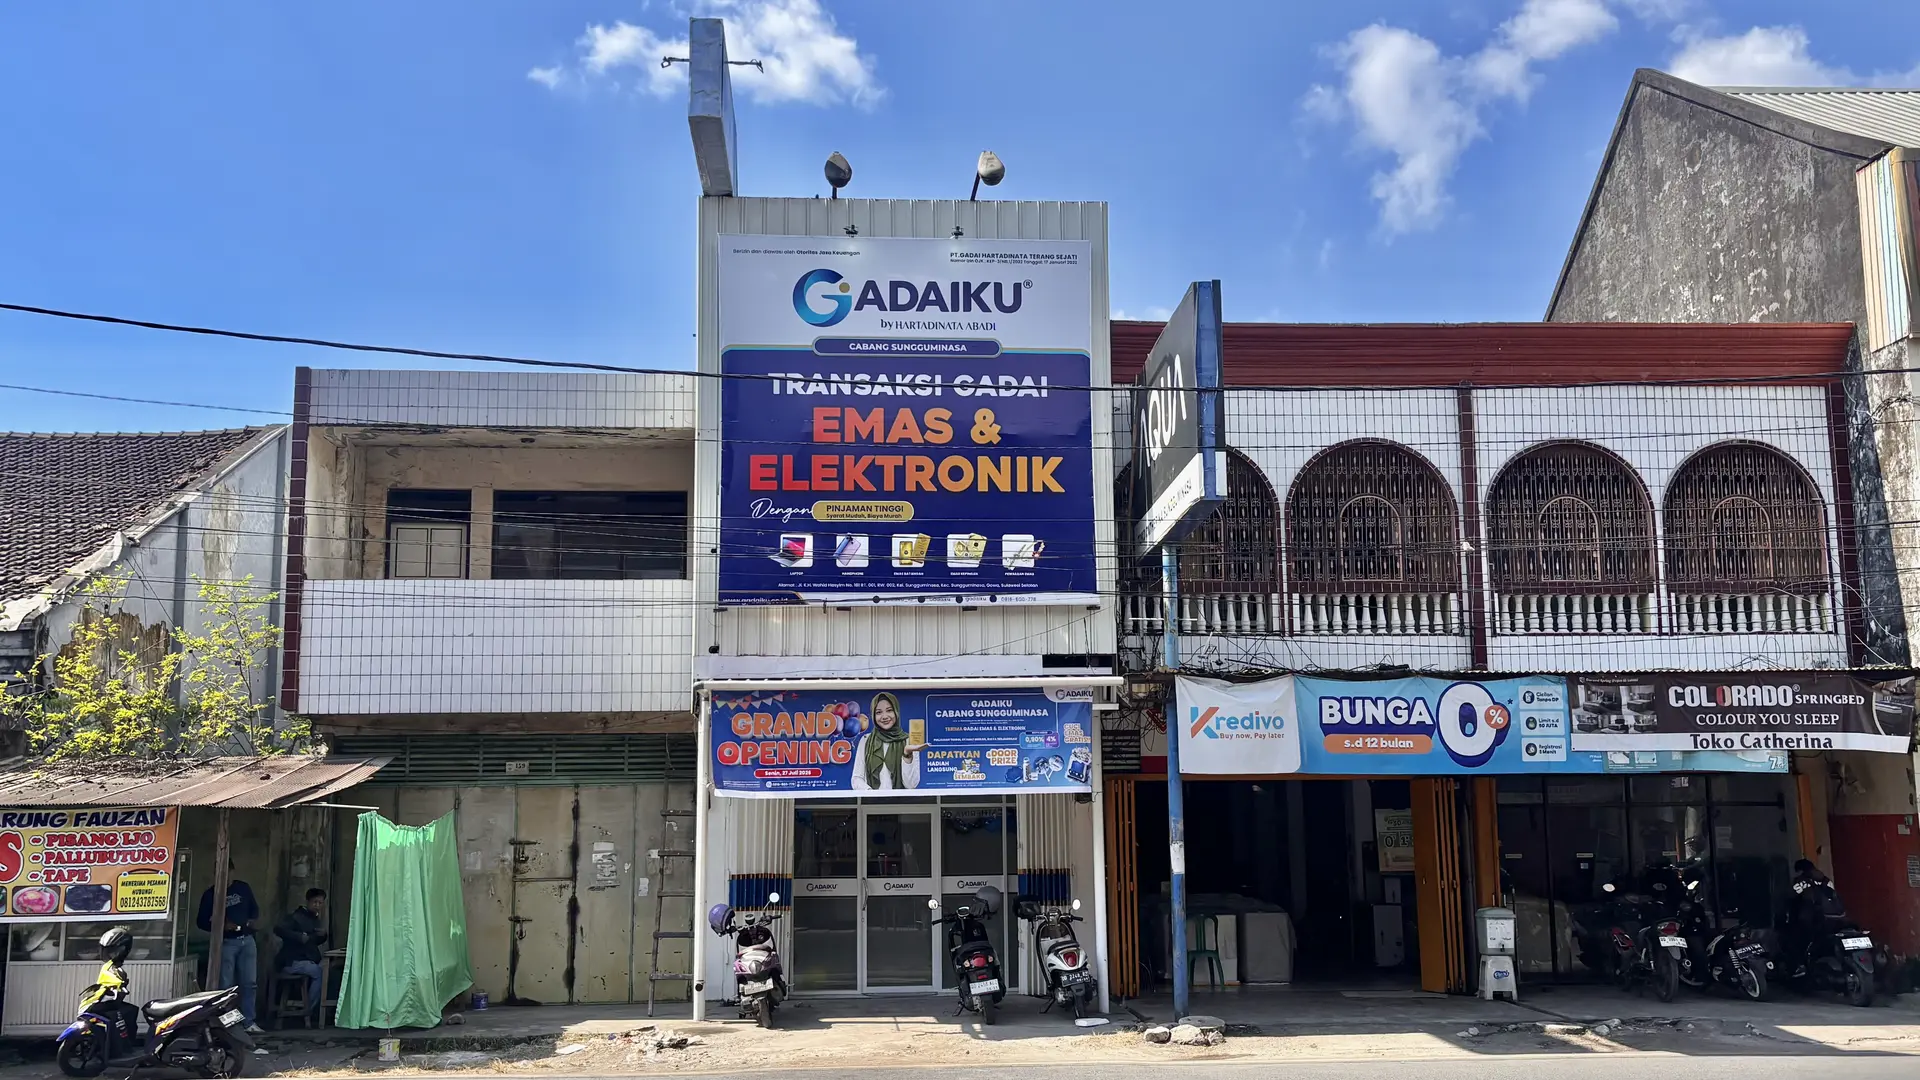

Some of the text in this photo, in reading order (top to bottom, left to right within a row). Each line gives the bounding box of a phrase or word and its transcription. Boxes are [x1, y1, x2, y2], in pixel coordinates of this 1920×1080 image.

[880, 318, 997, 331] by HARTADINATA ABADI
[849, 342, 967, 352] CABANG SUNGGUMINASA
[768, 373, 1048, 398] TRANSAKSI GADAI
[813, 407, 1002, 445] EMAS &
[750, 455, 1065, 493] ELEKTRONIK
[750, 498, 813, 524] Dengan
[826, 504, 904, 513] PINJAMAN TINGGI
[971, 699, 1012, 708] GADAIKU
[1794, 693, 1864, 706] SPRINGBED
[935, 708, 1049, 718] CABANG SUNGGUMINASA
[1320, 697, 1433, 726] BUNGA
[731, 712, 838, 737] GRAND
[1190, 706, 1285, 738] Kredivo
[1696, 713, 1839, 726] COLOUR YOU SLEEP
[1219, 732, 1232, 740] Buy
[1254, 732, 1266, 740] Pay
[1343, 736, 1413, 748] s.d 12 bulan
[1689, 732, 1833, 749] Toko Catherina
[717, 740, 852, 765] OPENING
[927, 750, 980, 759] DAPATKAN
[991, 757, 1017, 765] PRIZE
[0, 810, 165, 828] RUNG FAUZAN
[46, 832, 153, 847] PISANG IJO
[44, 848, 166, 864] PALLUBUTUNG
[43, 868, 88, 883] TAPE
[806, 882, 838, 892] GADAIKU
[884, 881, 915, 891] GADAIKU
[957, 879, 988, 889] GADAIKU
